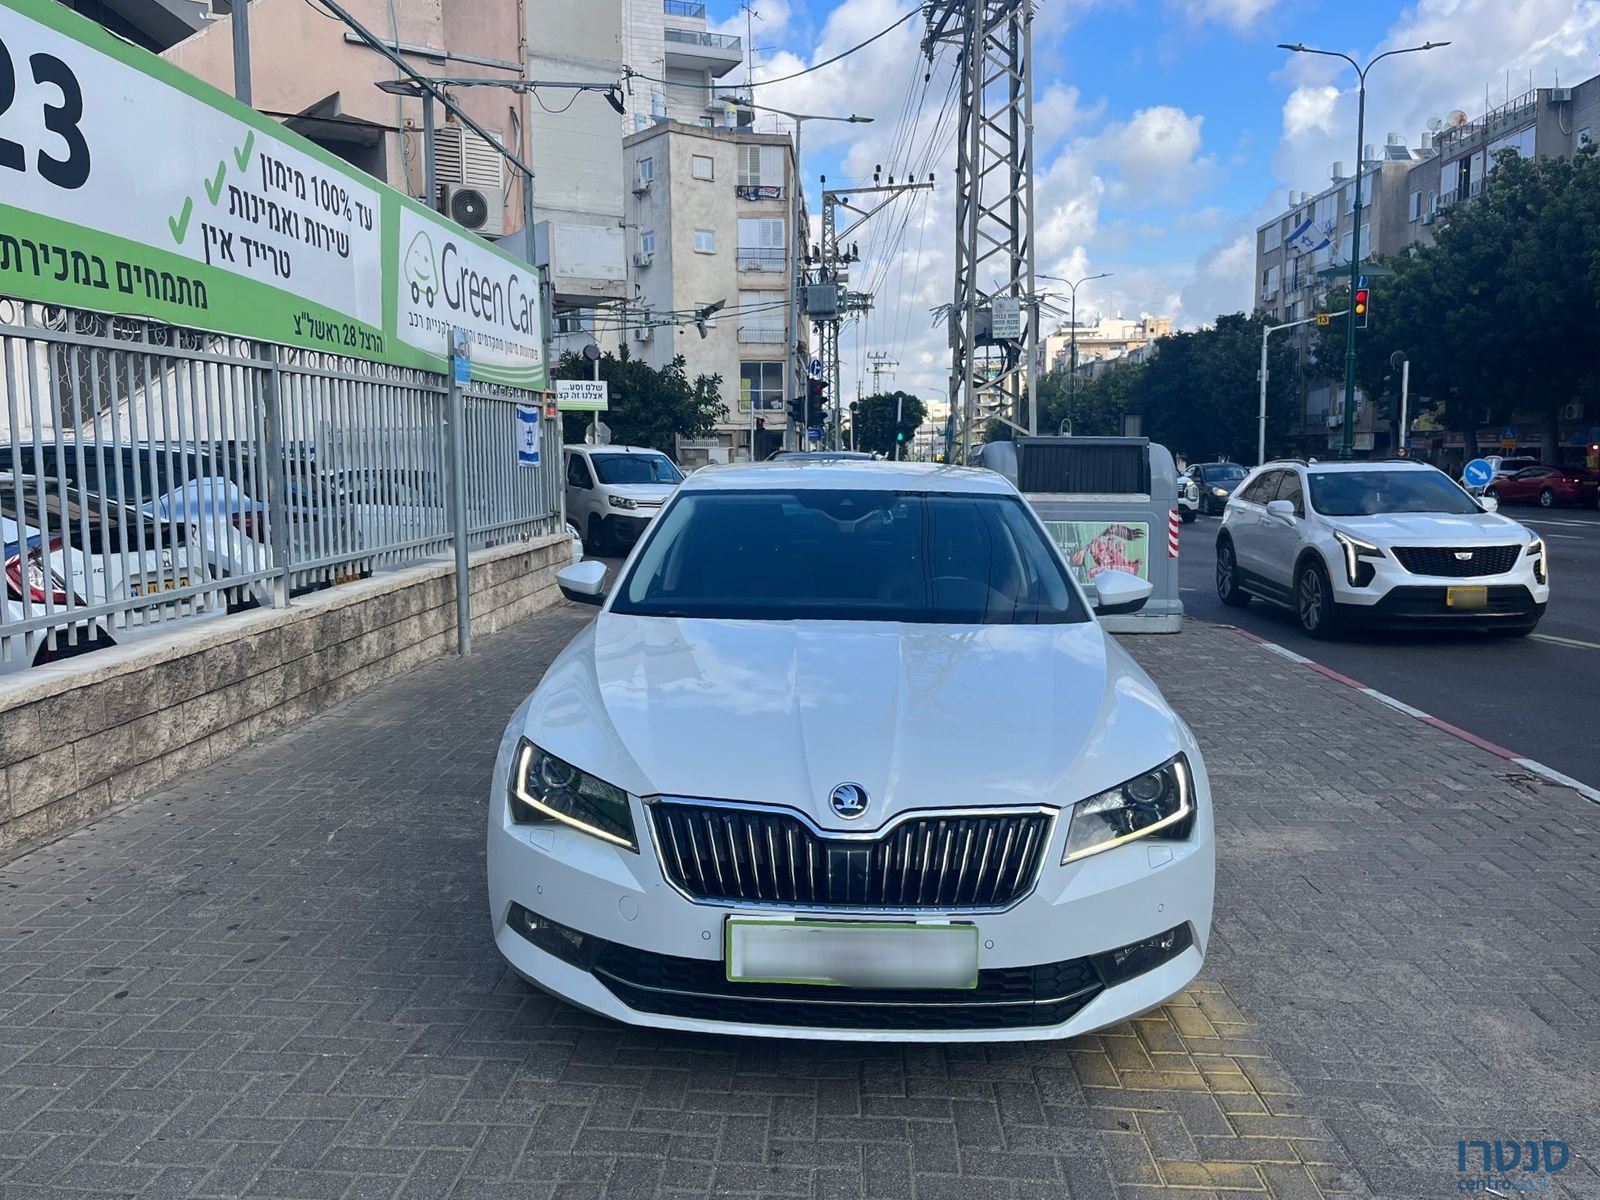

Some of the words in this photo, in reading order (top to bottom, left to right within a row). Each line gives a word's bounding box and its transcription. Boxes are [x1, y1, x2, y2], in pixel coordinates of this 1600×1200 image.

[260, 153, 306, 200] מימון
[228, 185, 300, 240] ואמינות
[311, 176, 352, 222] 100%
[355, 201, 373, 231] עד
[201, 223, 235, 265] אין
[304, 217, 349, 258] שירות
[0, 233, 109, 289] במכירת
[240, 236, 291, 279] טרייד
[116, 261, 208, 309] מתמחים
[441, 242, 504, 326] Green
[508, 274, 535, 336] Car
[293, 311, 341, 343] ראשל"צ
[342, 323, 357, 347] 28
[408, 311, 424, 331] רכב
[426, 315, 450, 339] לקניית
[1318, 315, 1328, 323] 13
[358, 326, 383, 353] הרצל
[582, 392, 603, 400] אצלנו
[585, 383, 603, 391] שלם
